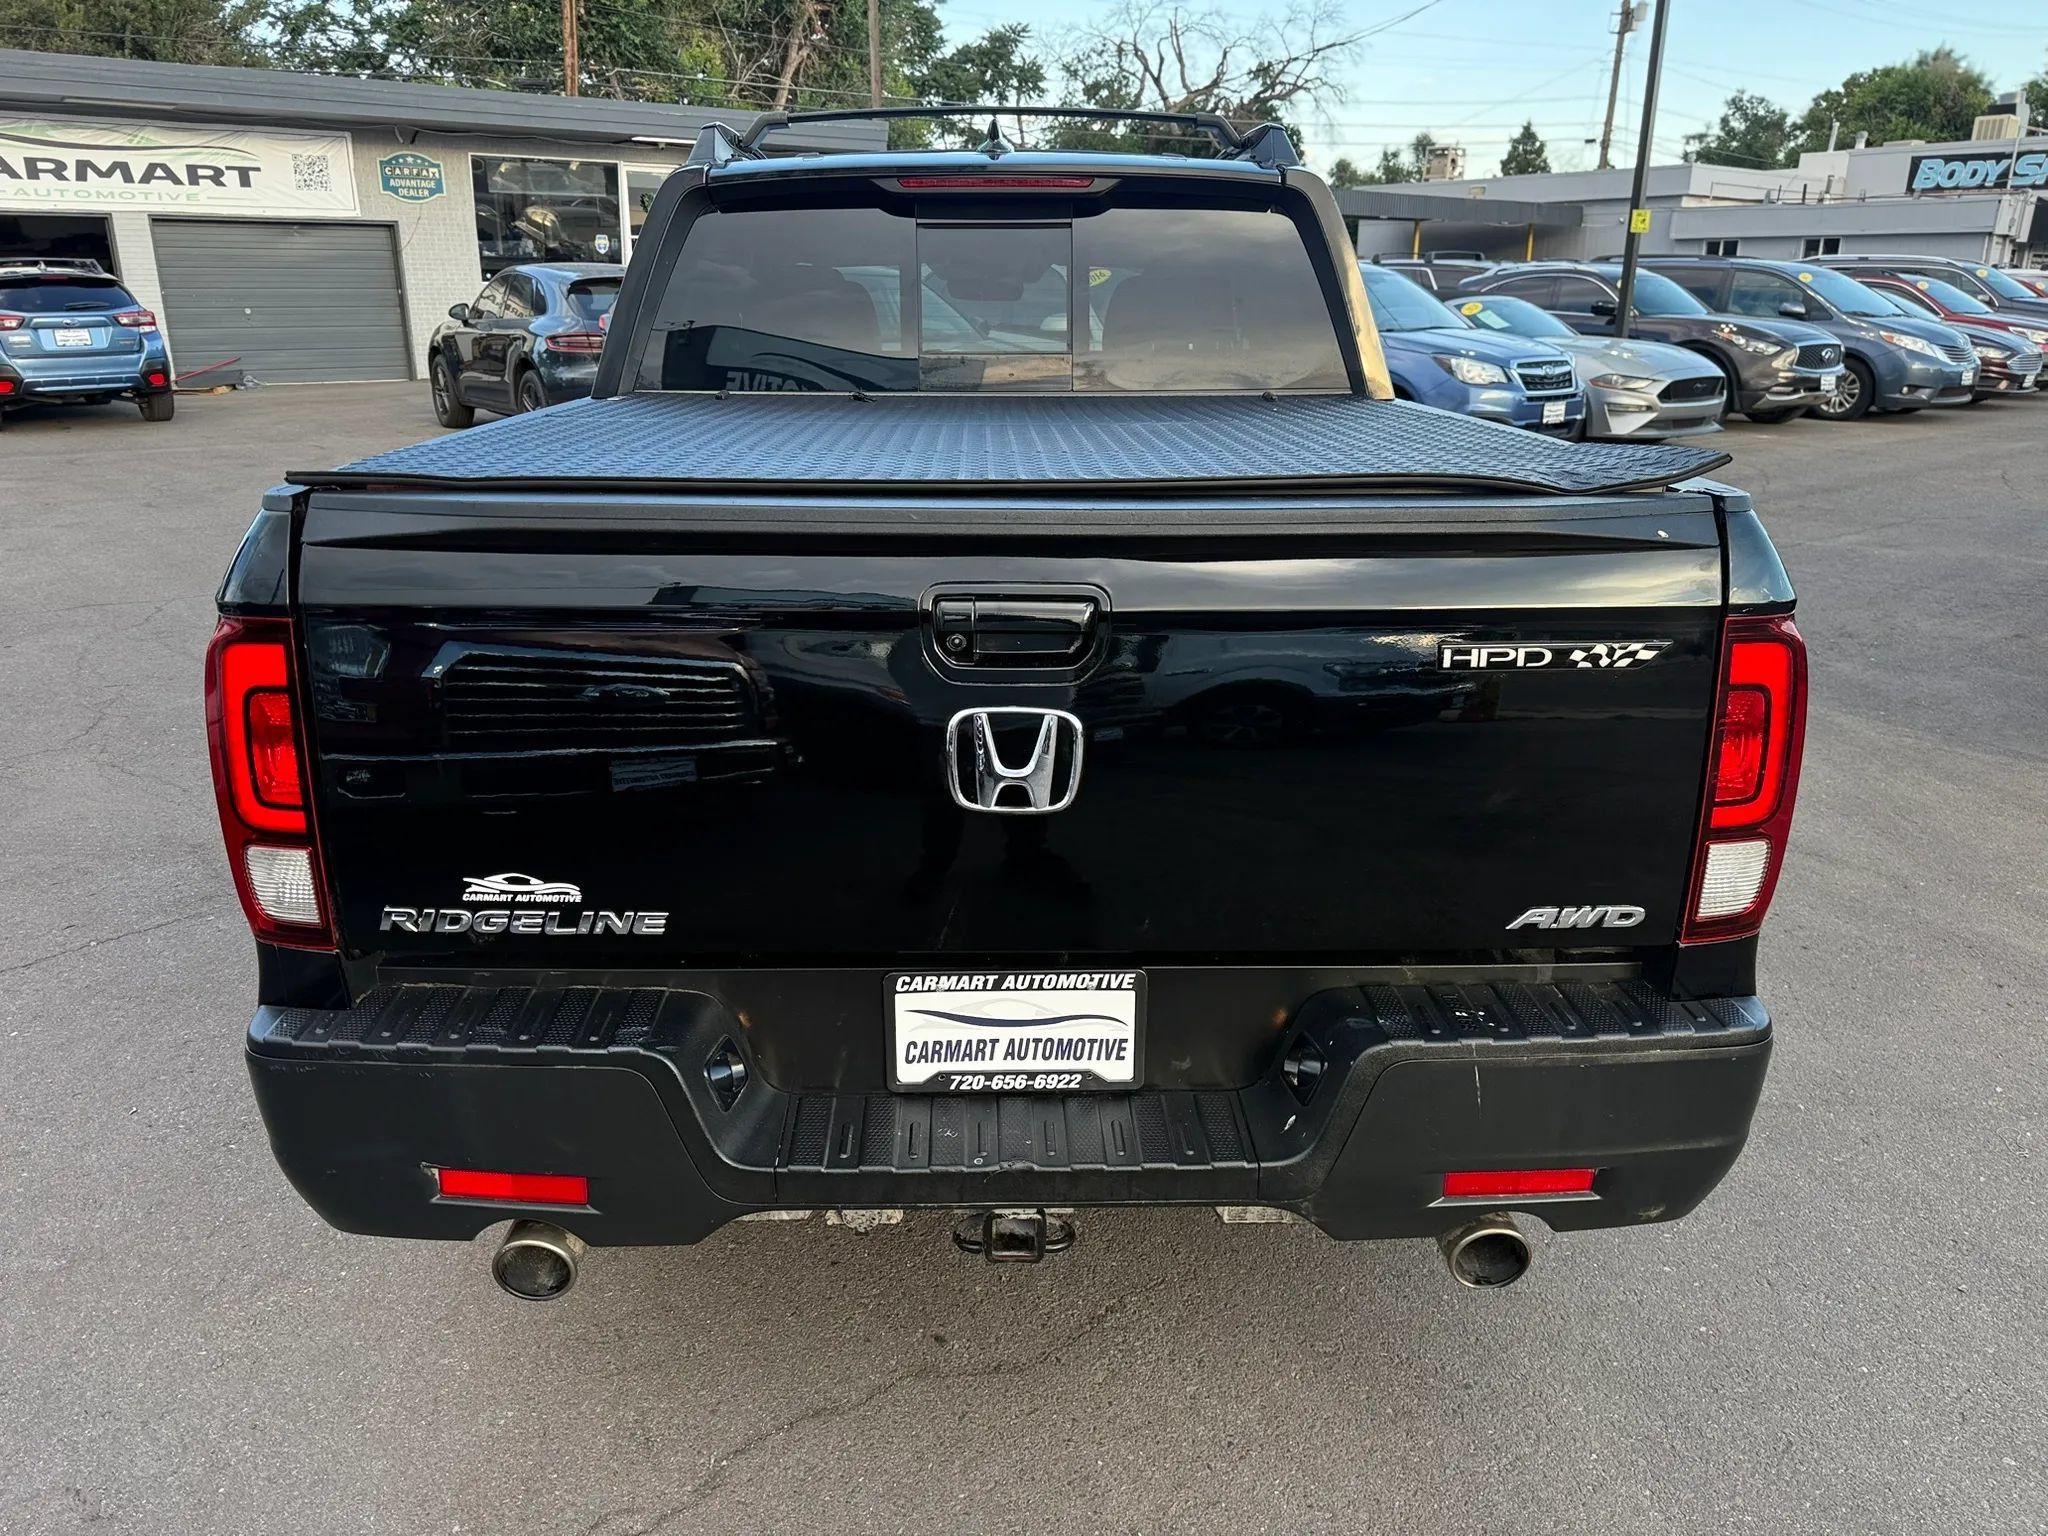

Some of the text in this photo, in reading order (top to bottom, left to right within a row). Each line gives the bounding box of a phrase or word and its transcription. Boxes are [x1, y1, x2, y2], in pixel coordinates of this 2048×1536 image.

[384, 166, 440, 179] CARFAX
[1912, 158, 2012, 189] BODY
[389, 178, 437, 188] ADVANTAGE
[398, 187, 430, 197] DEALER
[13, 187, 200, 202] AUTOMOTIVE
[1442, 647, 1553, 668] HPD
[462, 894, 582, 903] CARMART AUTOMOTIVE
[379, 906, 669, 935] RIDGELINE
[1505, 905, 1646, 929] AWD
[895, 973, 1136, 992] CARMART AUTOMOTIVE
[904, 1037, 1129, 1064] CARMART AUTOMOTIVE
[949, 1073, 1082, 1091] 720-656-6922
